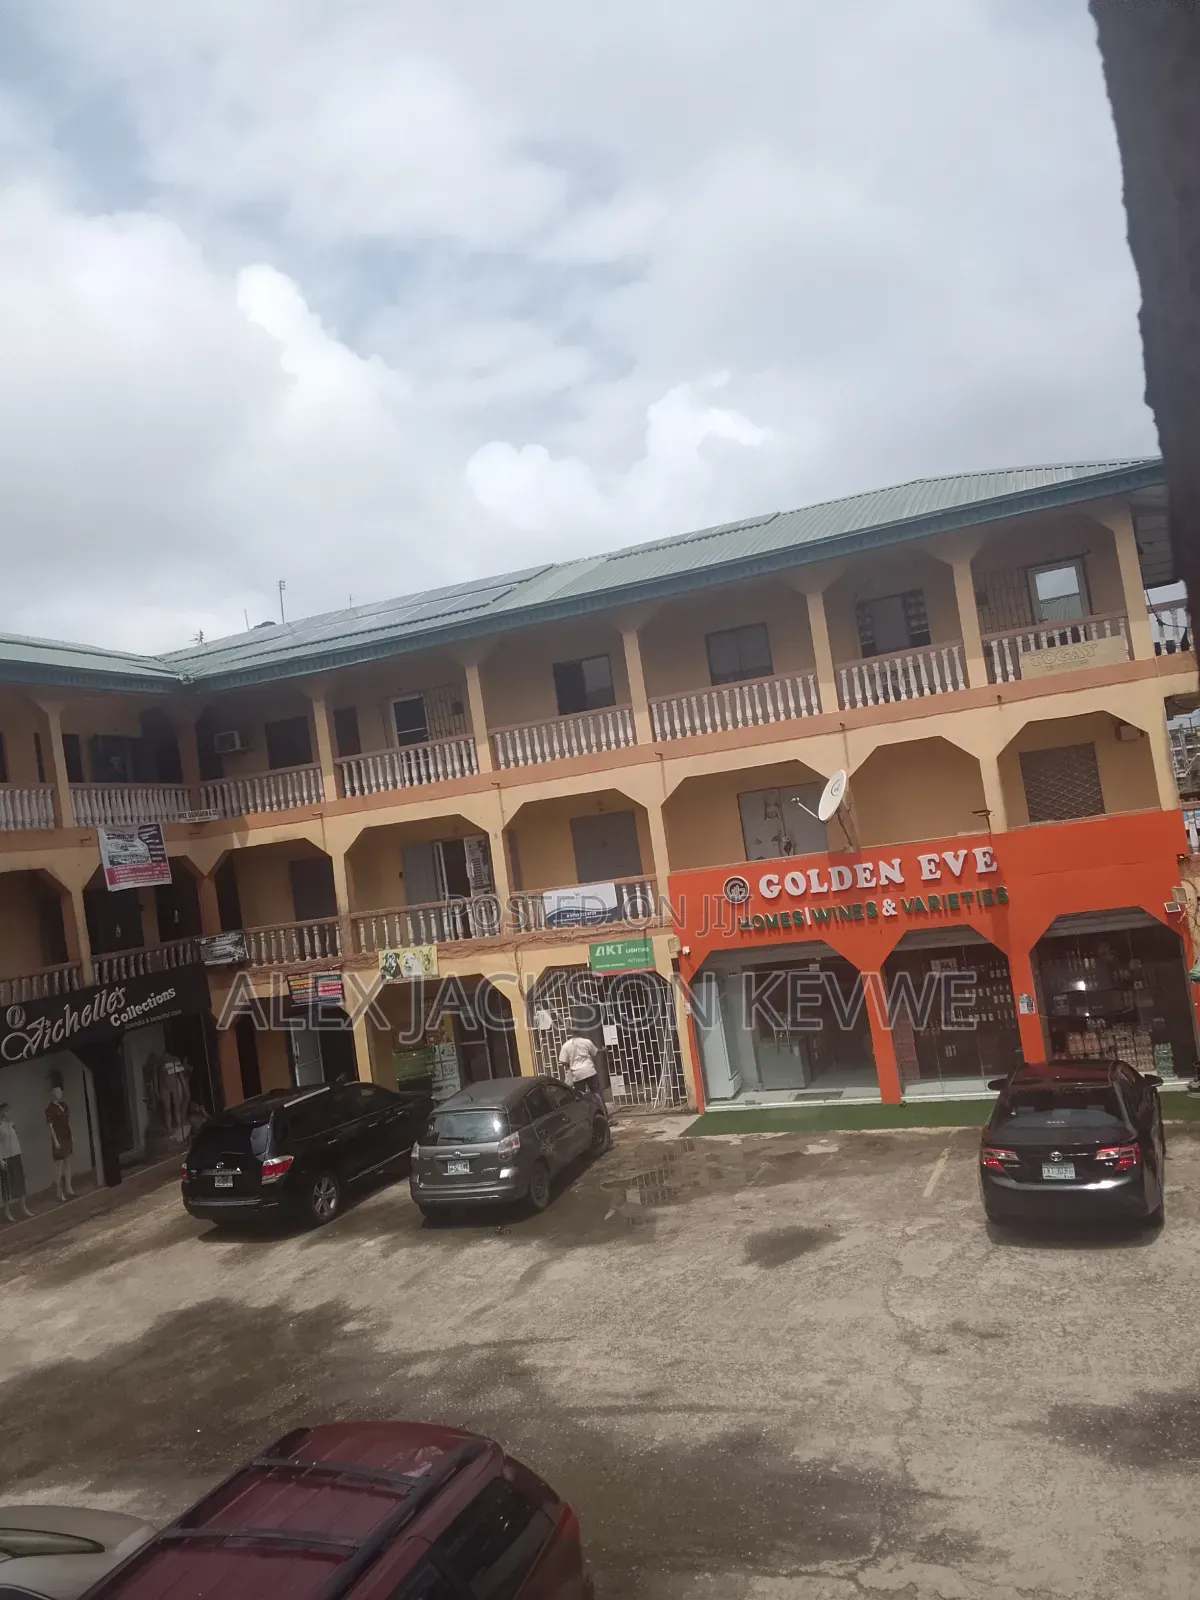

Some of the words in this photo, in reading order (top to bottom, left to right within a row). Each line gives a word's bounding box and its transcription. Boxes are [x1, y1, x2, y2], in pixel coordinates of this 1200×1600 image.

[758, 858, 905, 899] GOLDEN
[917, 846, 998, 881] EVE
[882, 898, 898, 917] &
[900, 886, 1009, 914] VARIETIES
[110, 988, 176, 1027] Collections
